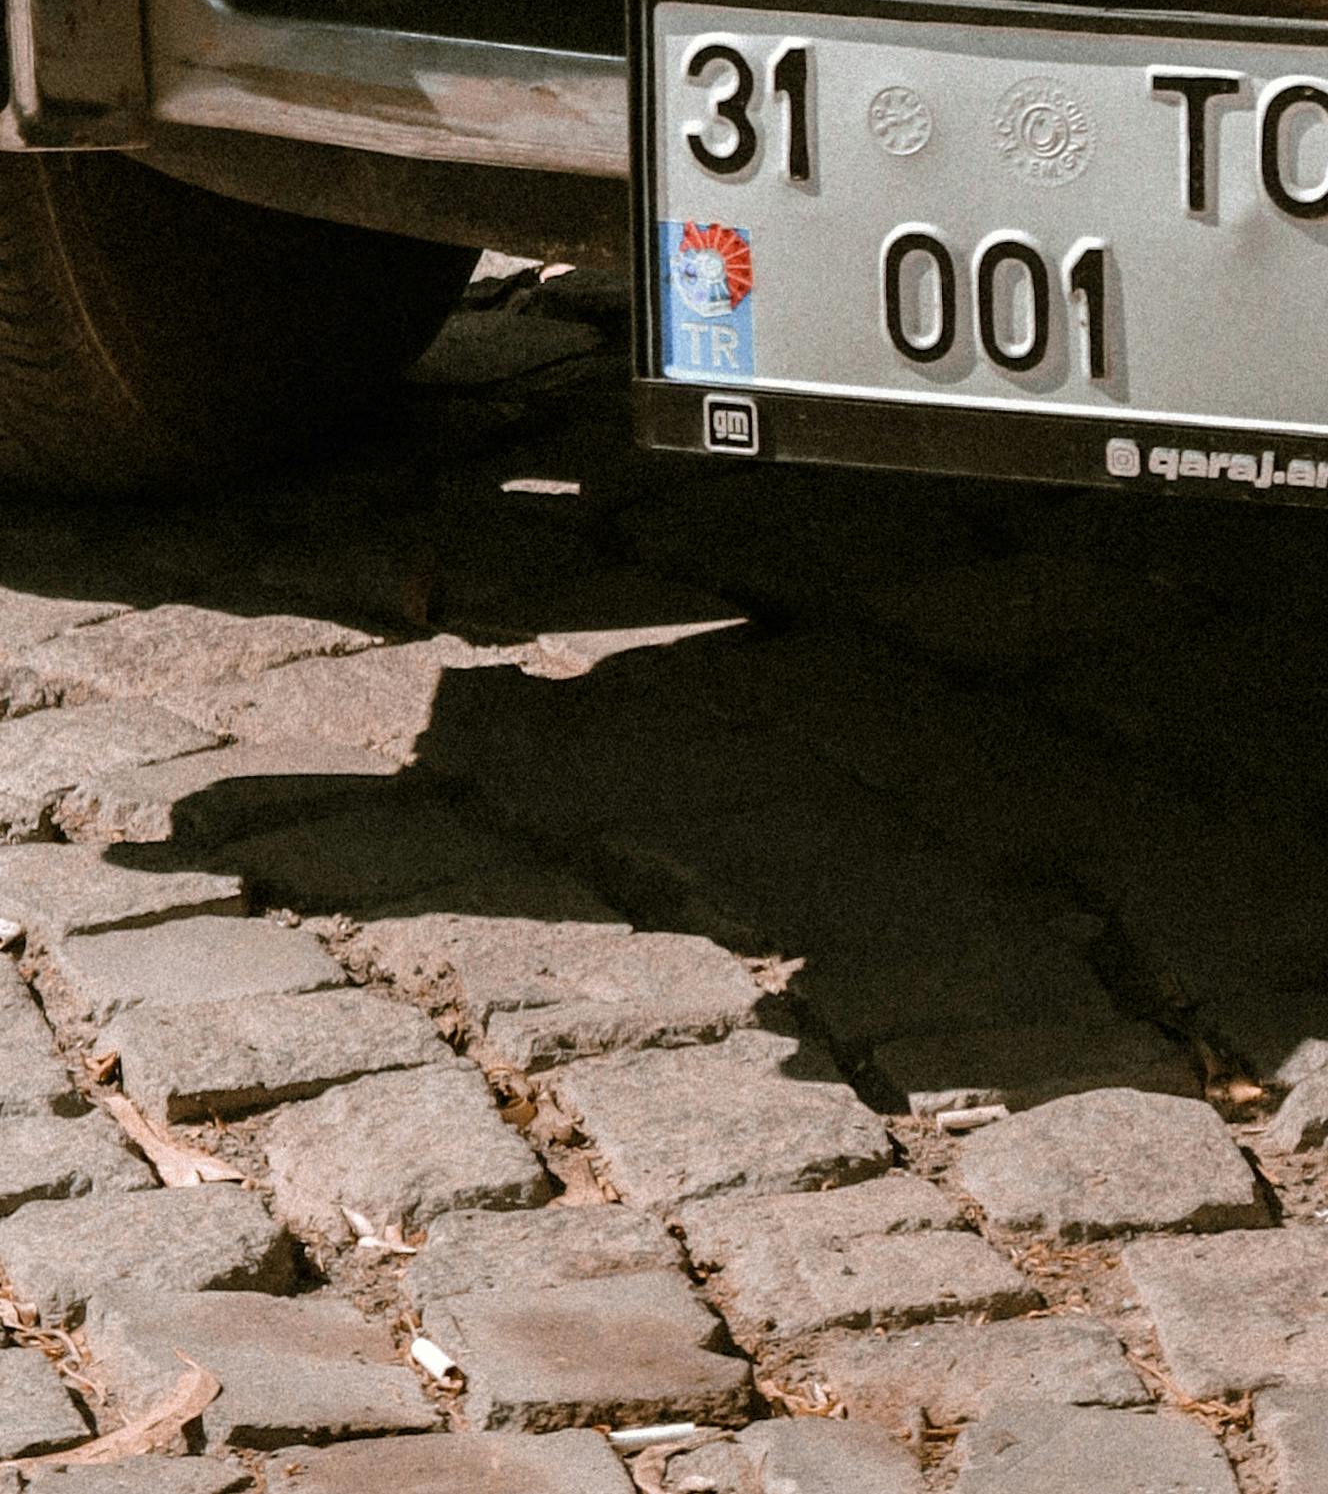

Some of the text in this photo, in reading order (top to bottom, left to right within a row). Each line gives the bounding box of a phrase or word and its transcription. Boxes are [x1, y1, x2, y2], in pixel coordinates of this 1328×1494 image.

[684, 37, 810, 183] 31
[681, 323, 739, 369] TR
[882, 227, 1107, 381] 001
[712, 410, 750, 442] gm
